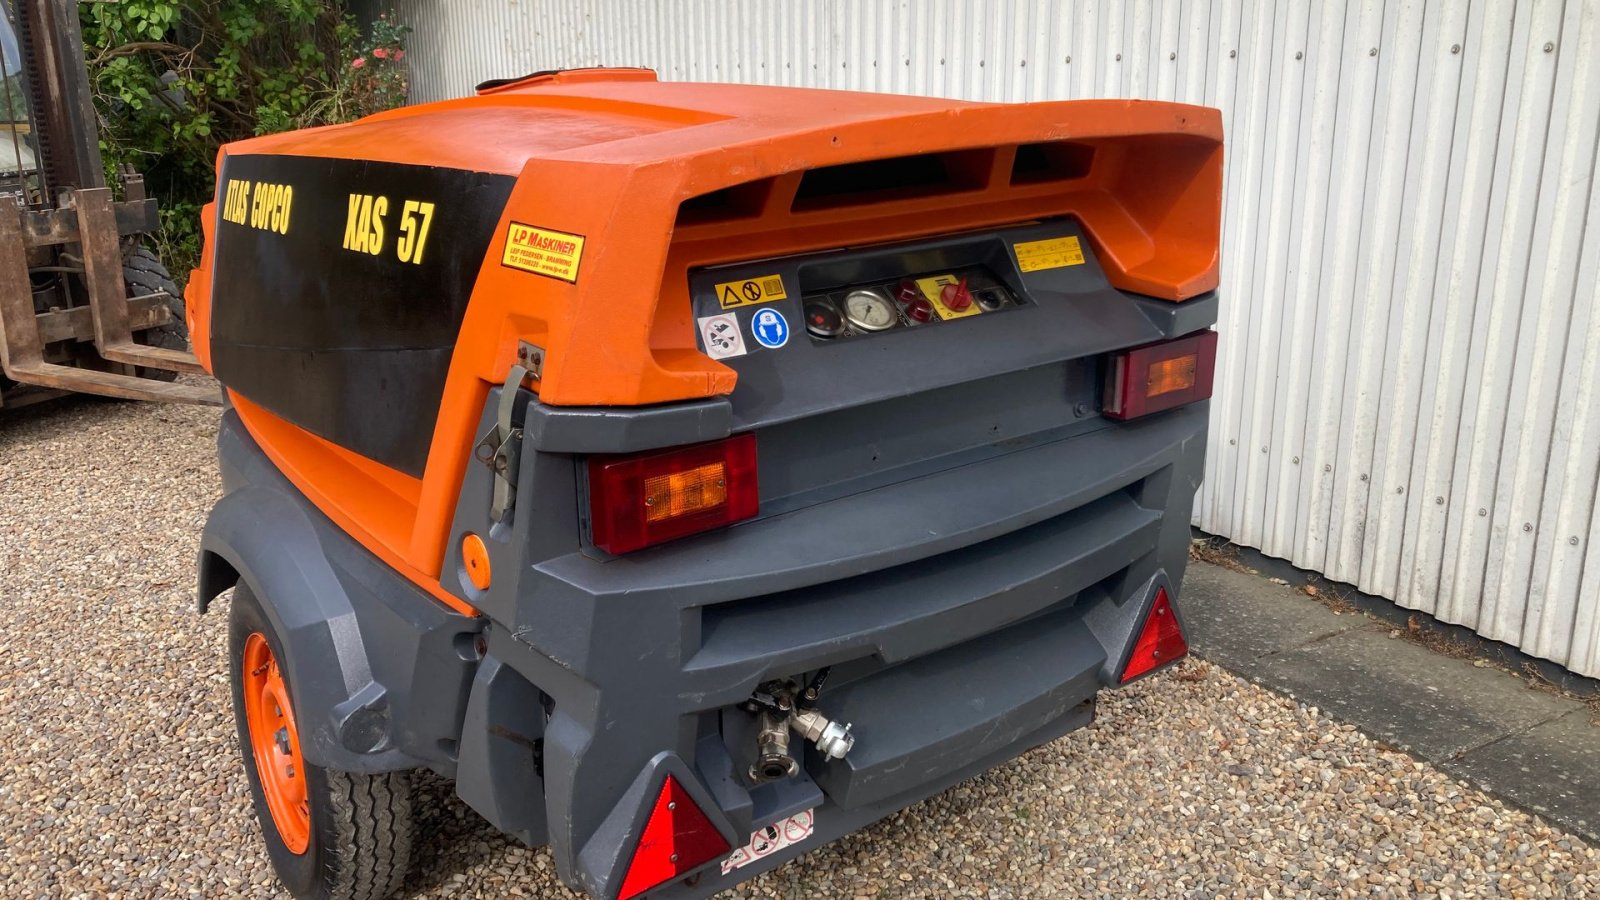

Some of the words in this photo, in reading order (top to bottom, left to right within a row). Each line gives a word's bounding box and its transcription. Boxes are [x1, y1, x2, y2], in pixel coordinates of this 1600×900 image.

[223, 179, 250, 225] ATLAS
[251, 182, 292, 235] COPCO
[343, 194, 388, 255] XAS
[397, 200, 435, 264] 57
[513, 228, 527, 243] LP
[528, 232, 576, 255] MASKINER
